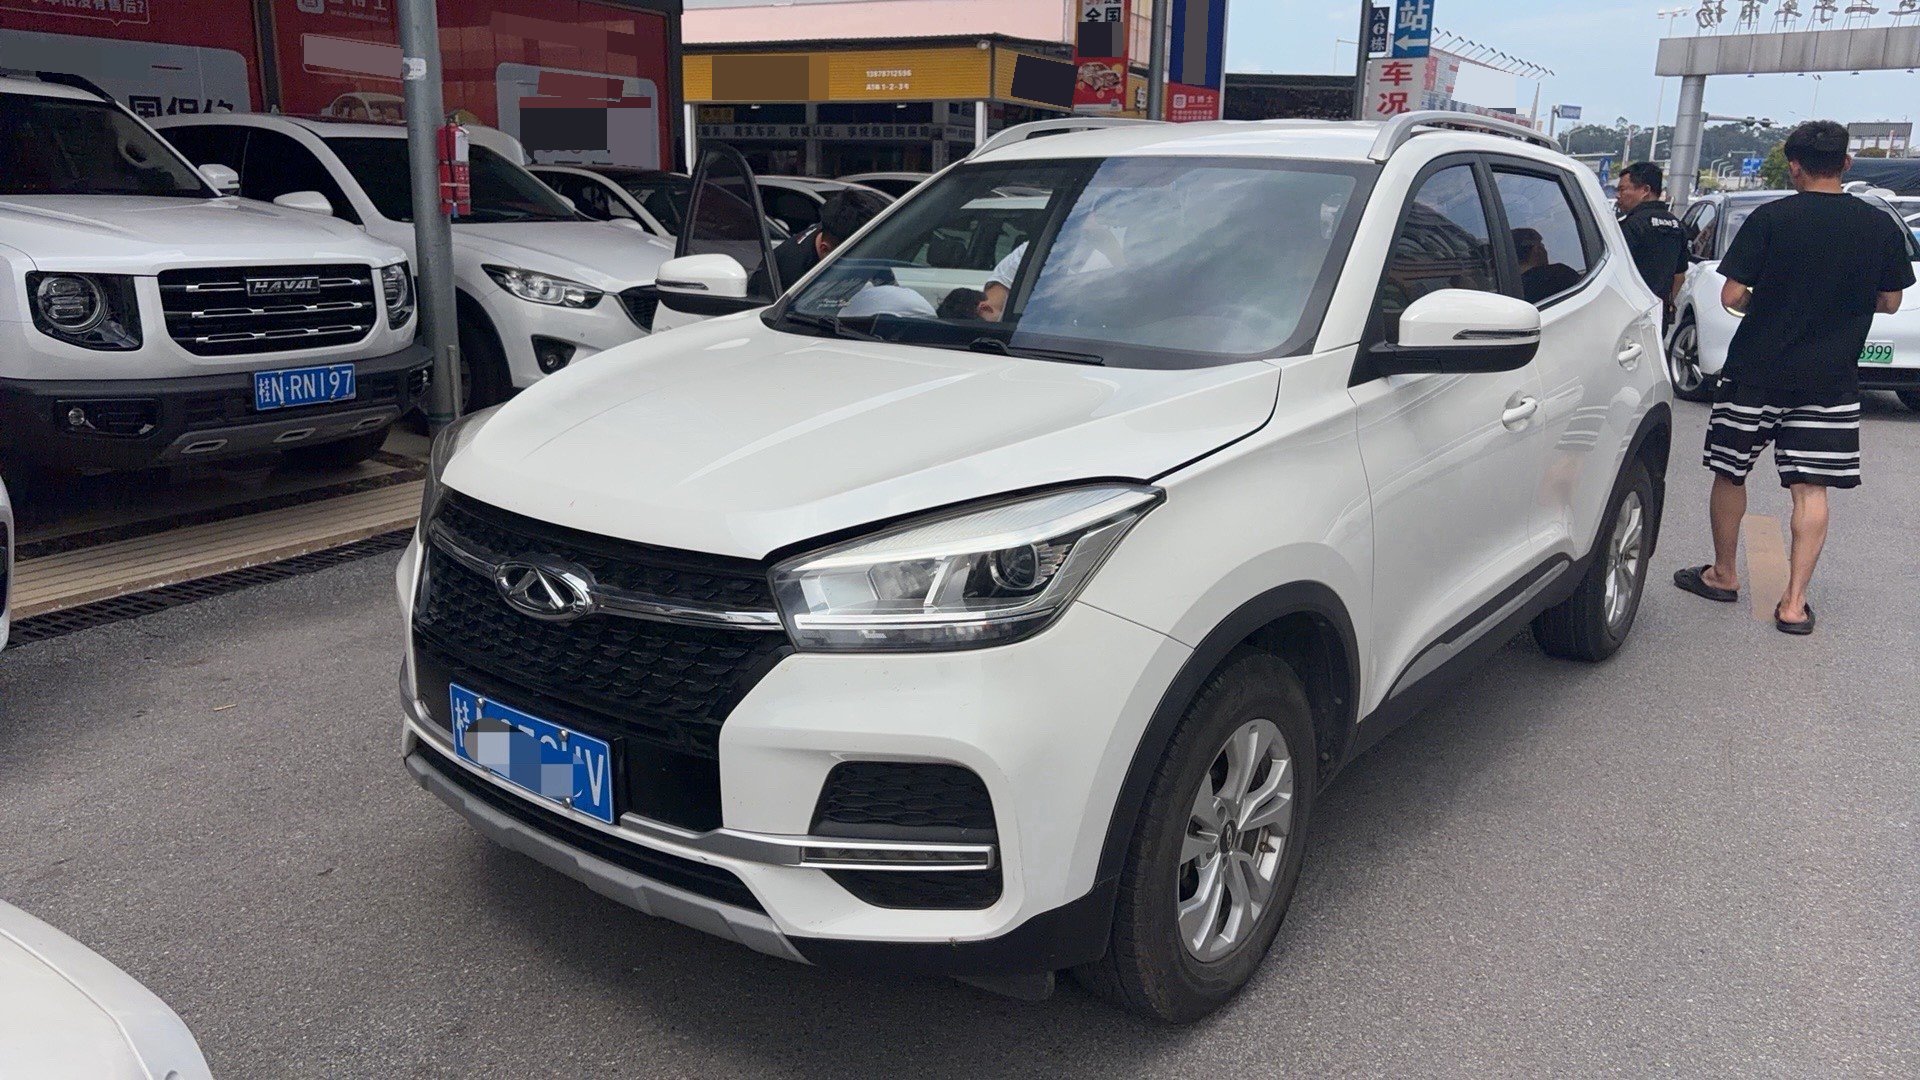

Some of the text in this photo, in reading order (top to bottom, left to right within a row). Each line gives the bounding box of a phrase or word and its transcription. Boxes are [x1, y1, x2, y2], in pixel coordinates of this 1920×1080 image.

[1371, 9, 1386, 51] A6栋
[1398, 0, 1431, 31] 站
[1377, 61, 1413, 115] 车况
[253, 280, 318, 293] HAVAL
